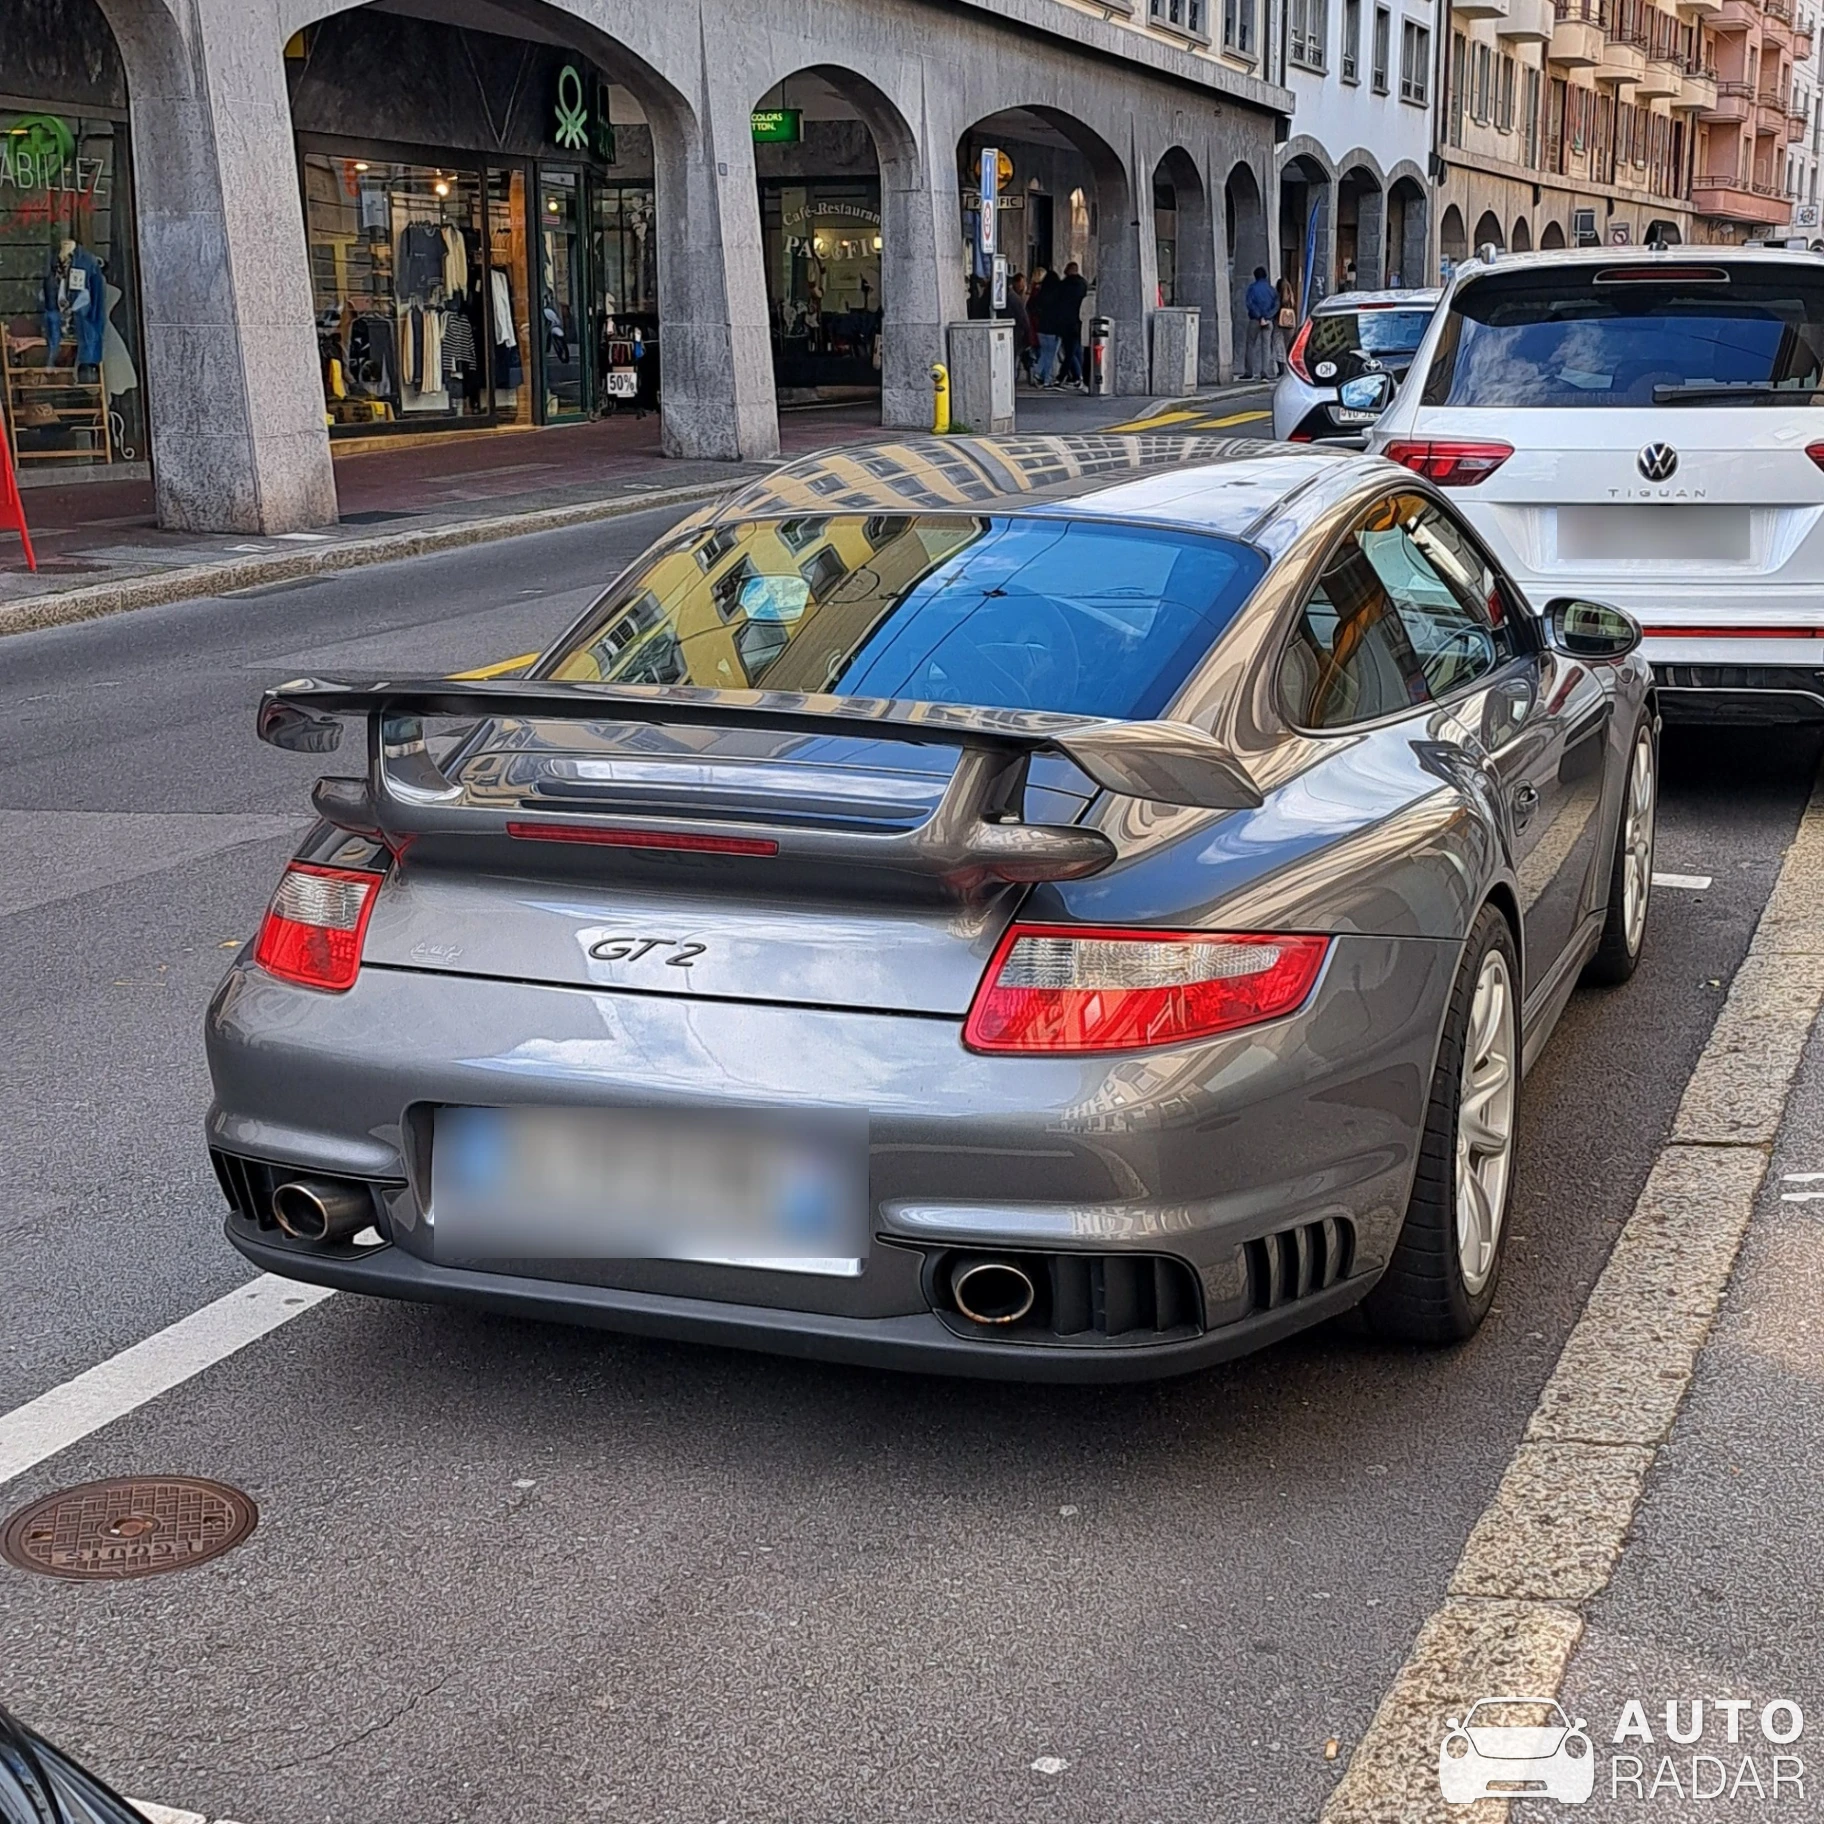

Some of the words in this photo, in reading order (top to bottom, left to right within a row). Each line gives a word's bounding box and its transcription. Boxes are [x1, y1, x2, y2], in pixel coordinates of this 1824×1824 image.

[751, 113, 783, 122] COLORS
[1320, 363, 1332, 375] CH
[610, 374, 634, 392] 50%
[1608, 488, 1706, 498] TIGUAN
